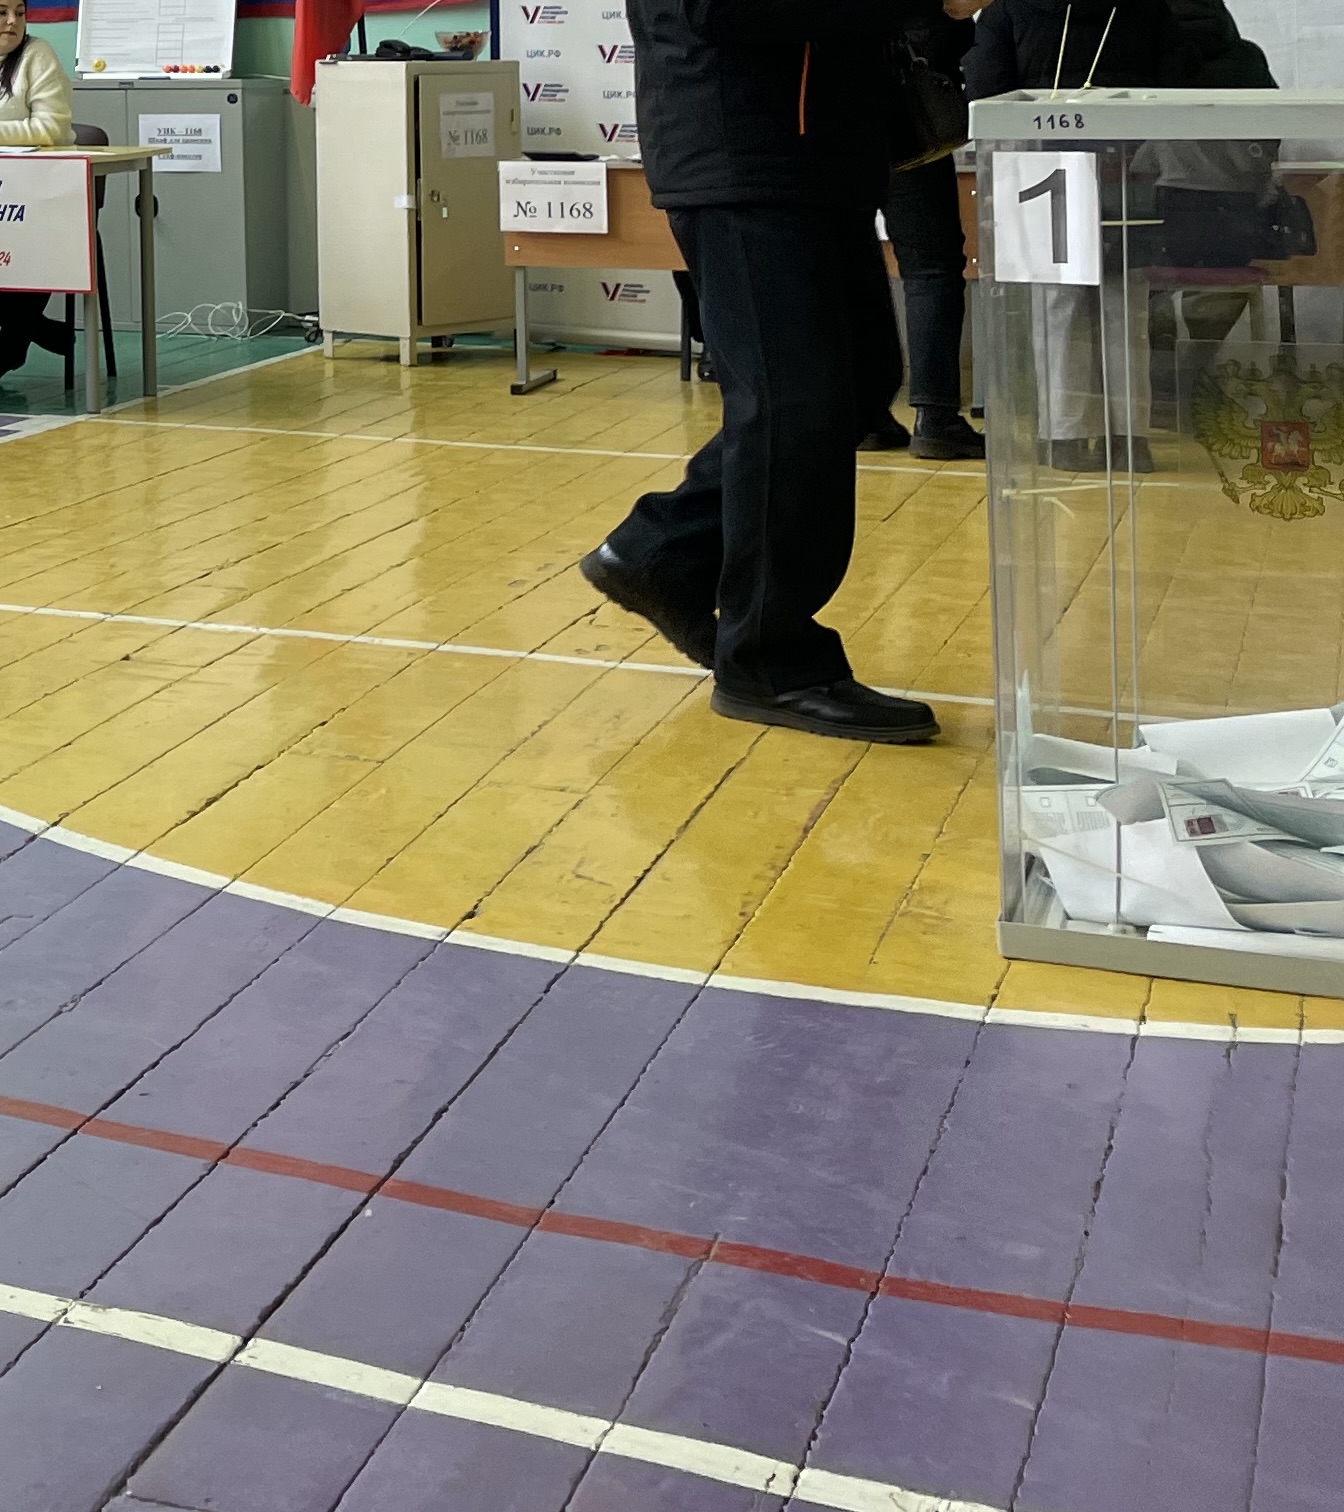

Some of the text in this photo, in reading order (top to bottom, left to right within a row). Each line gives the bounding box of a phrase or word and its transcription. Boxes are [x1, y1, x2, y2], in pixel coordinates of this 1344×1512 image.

[526, 50, 561, 58] ЦИК.РФ
[1033, 114, 1084, 130] 1168
[527, 127, 561, 136] ЦИК.РФ
[514, 201, 593, 219] № 1168
[1019, 169, 1068, 263] 1
